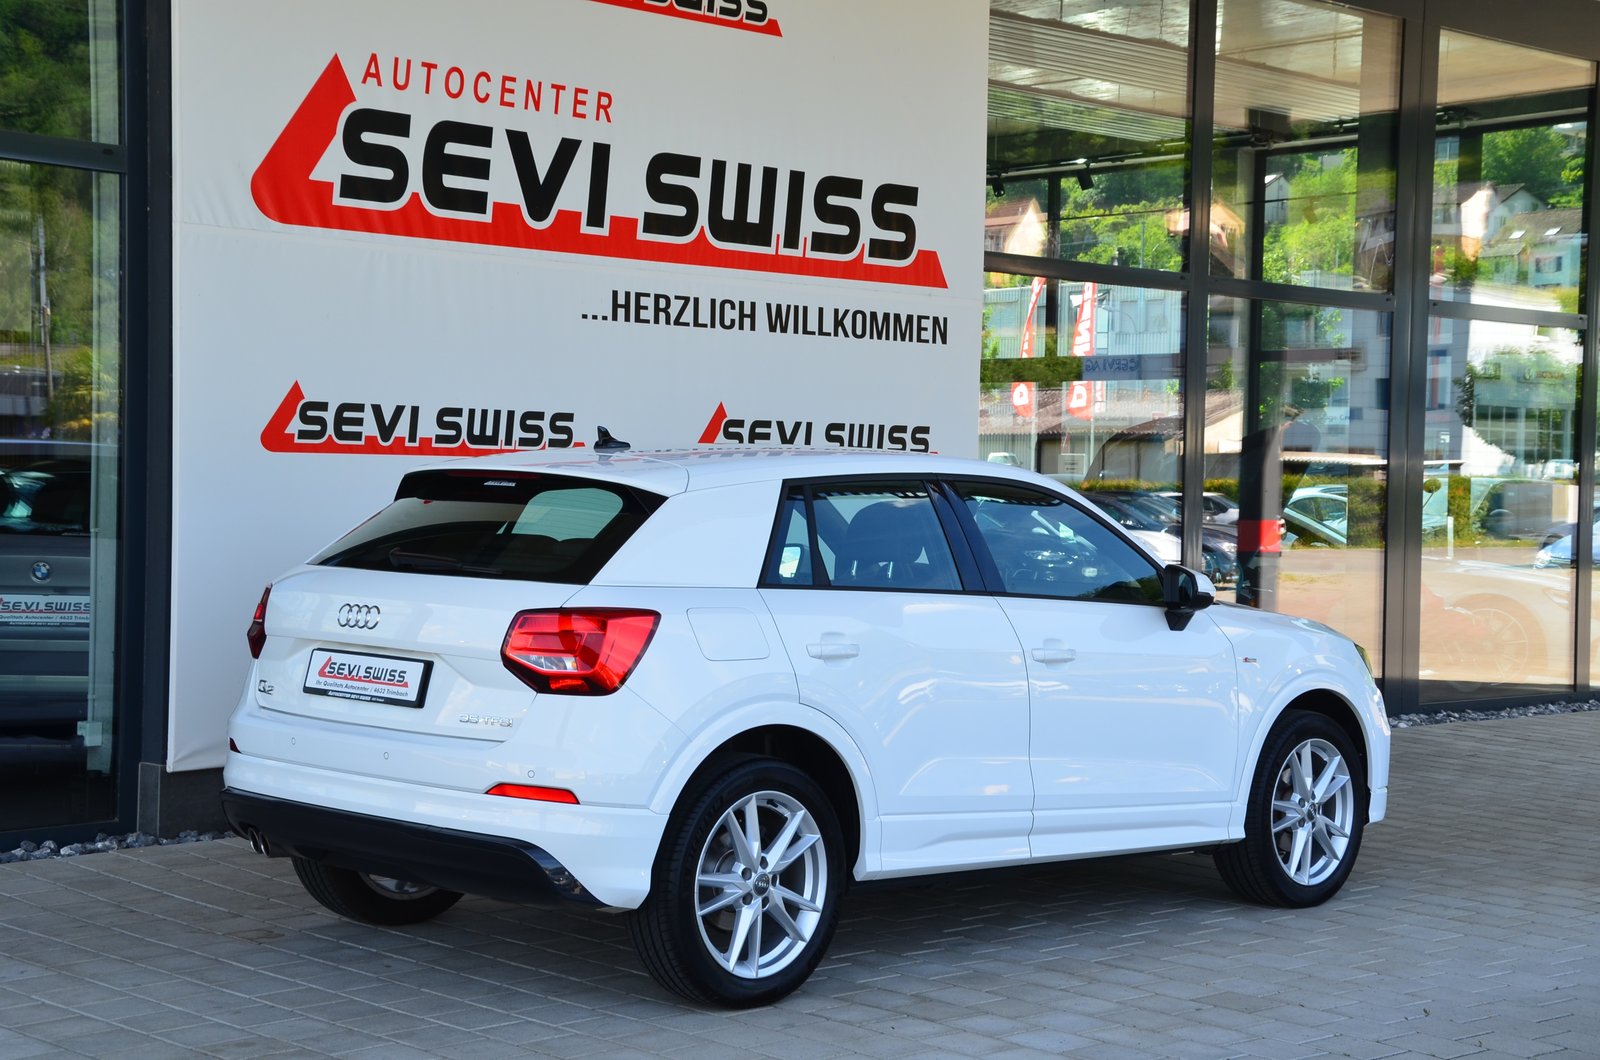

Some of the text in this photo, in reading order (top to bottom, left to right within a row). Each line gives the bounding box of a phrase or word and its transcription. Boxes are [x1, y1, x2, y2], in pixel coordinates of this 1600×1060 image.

[361, 52, 613, 123] AUTOCENTER
[339, 108, 919, 261] SEVI SWISS
[580, 290, 948, 345] ...HERZLICH WILLKOMMEN
[297, 401, 574, 448] SEVI SWISS
[723, 419, 931, 453] SEVI SWISS
[1, 601, 39, 611] SEVI
[258, 679, 274, 695] Q2
[327, 661, 407, 684] SEVI SWISS
[344, 683, 370, 692] Autocenter
[386, 688, 409, 697] Trimbach
